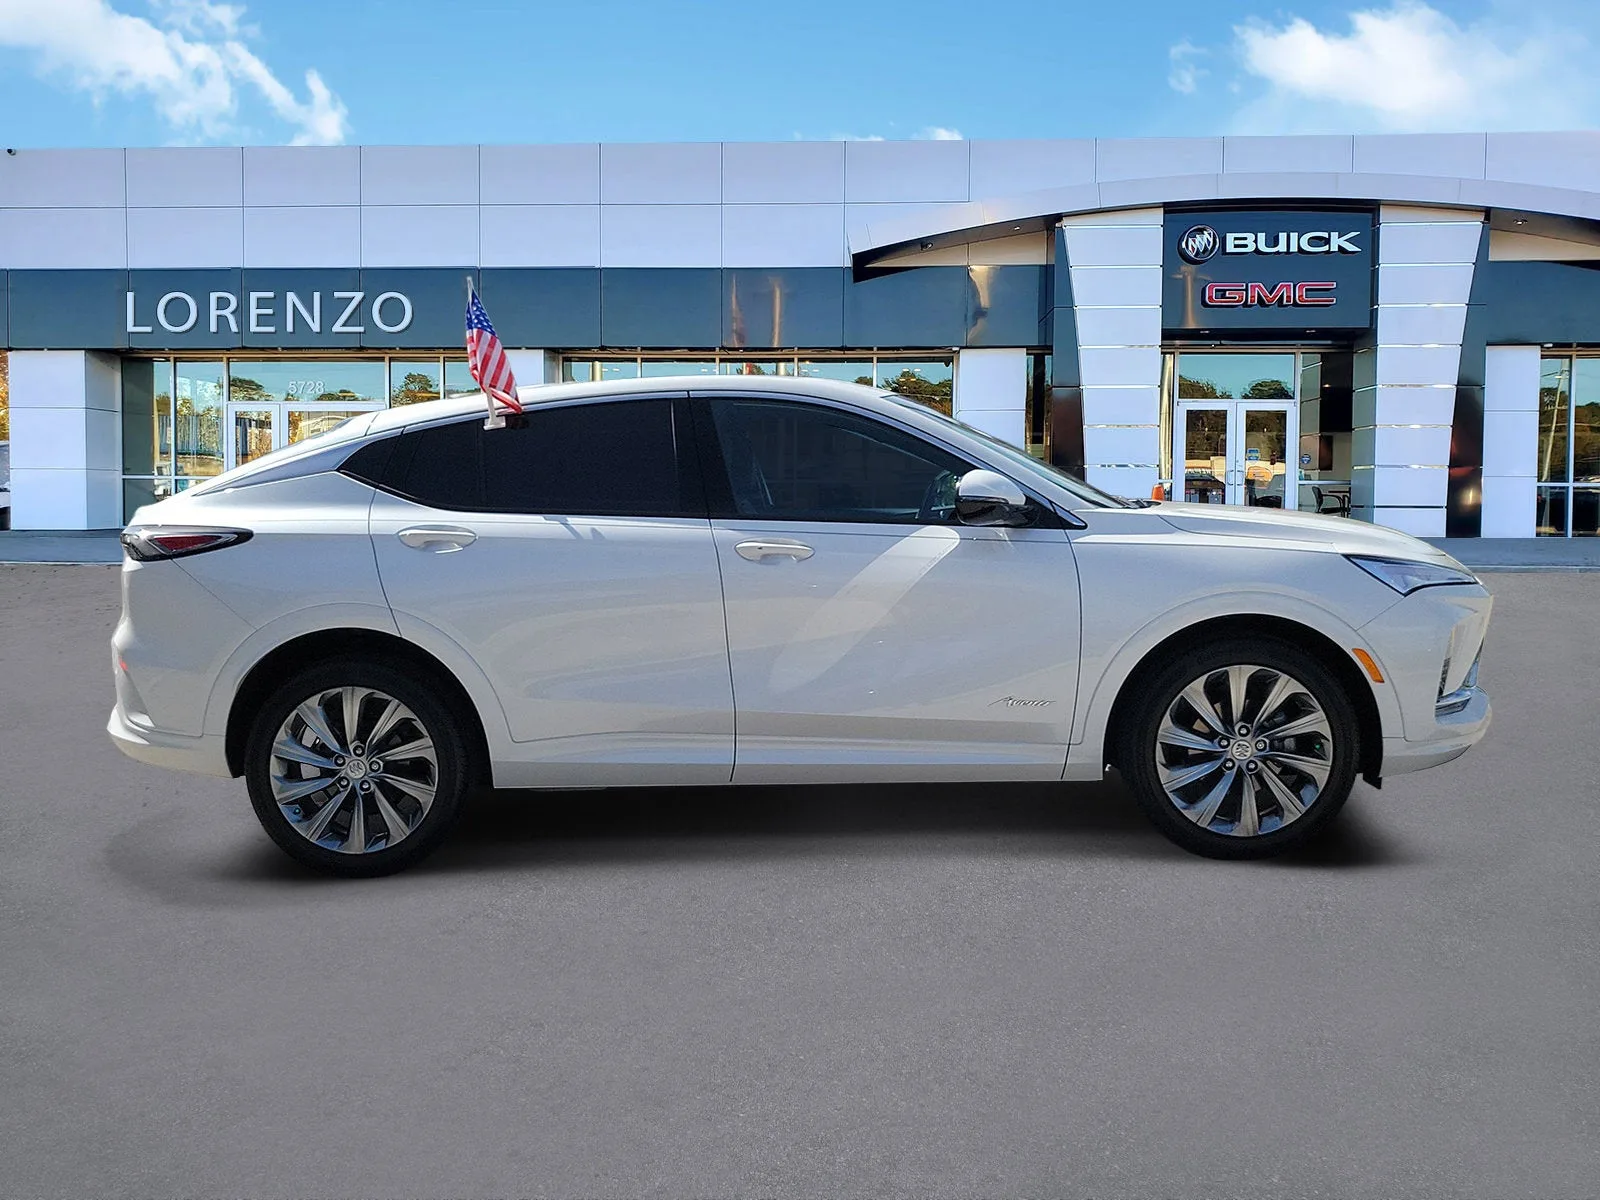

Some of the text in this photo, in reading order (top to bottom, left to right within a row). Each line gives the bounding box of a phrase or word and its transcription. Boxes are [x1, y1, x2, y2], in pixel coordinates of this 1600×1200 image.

[1225, 231, 1362, 254] BUICK
[1204, 281, 1337, 306] GMC
[126, 291, 413, 333] LORENZO
[288, 381, 325, 395] 5728
